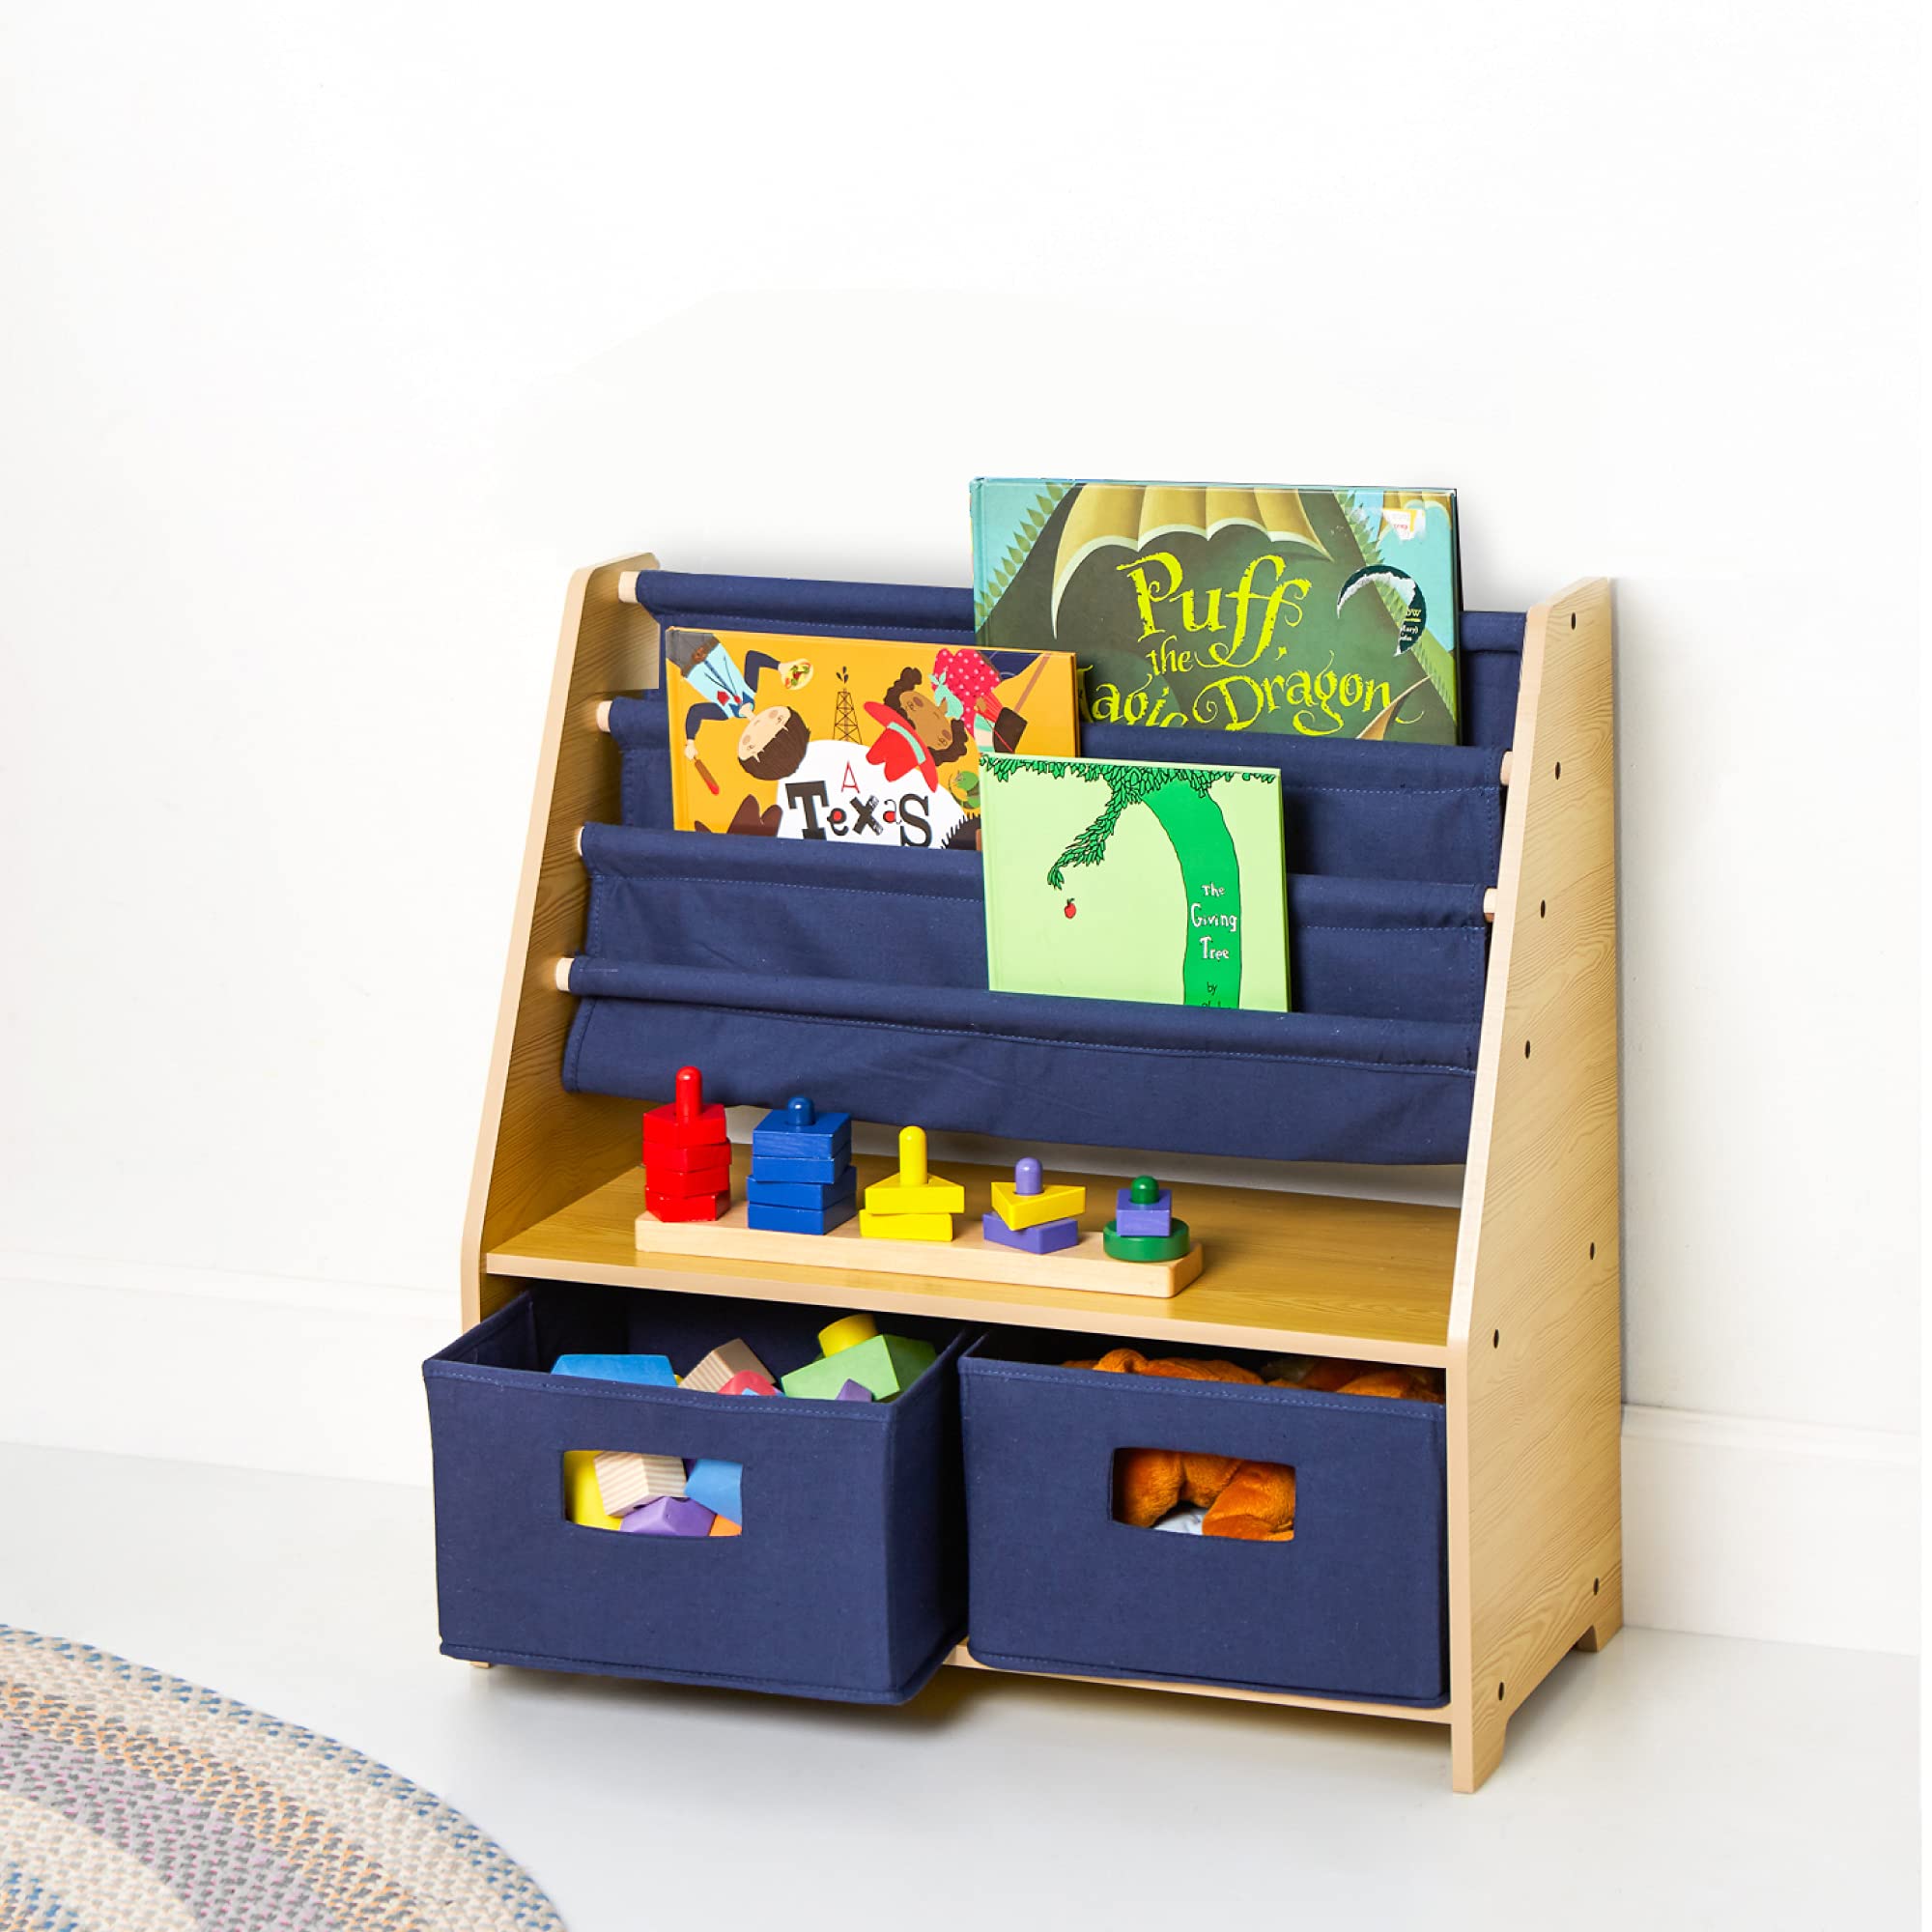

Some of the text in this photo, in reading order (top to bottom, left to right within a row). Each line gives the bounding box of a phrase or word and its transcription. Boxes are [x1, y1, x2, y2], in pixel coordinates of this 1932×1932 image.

[1146, 635, 1193, 675] the
[1076, 650, 1424, 736] agi Dragon
[840, 761, 860, 793] A
[1201, 882, 1226, 897] The
[1190, 902, 1237, 932] Giving
[1199, 936, 1230, 959] Tree
[1207, 981, 1218, 995] by
